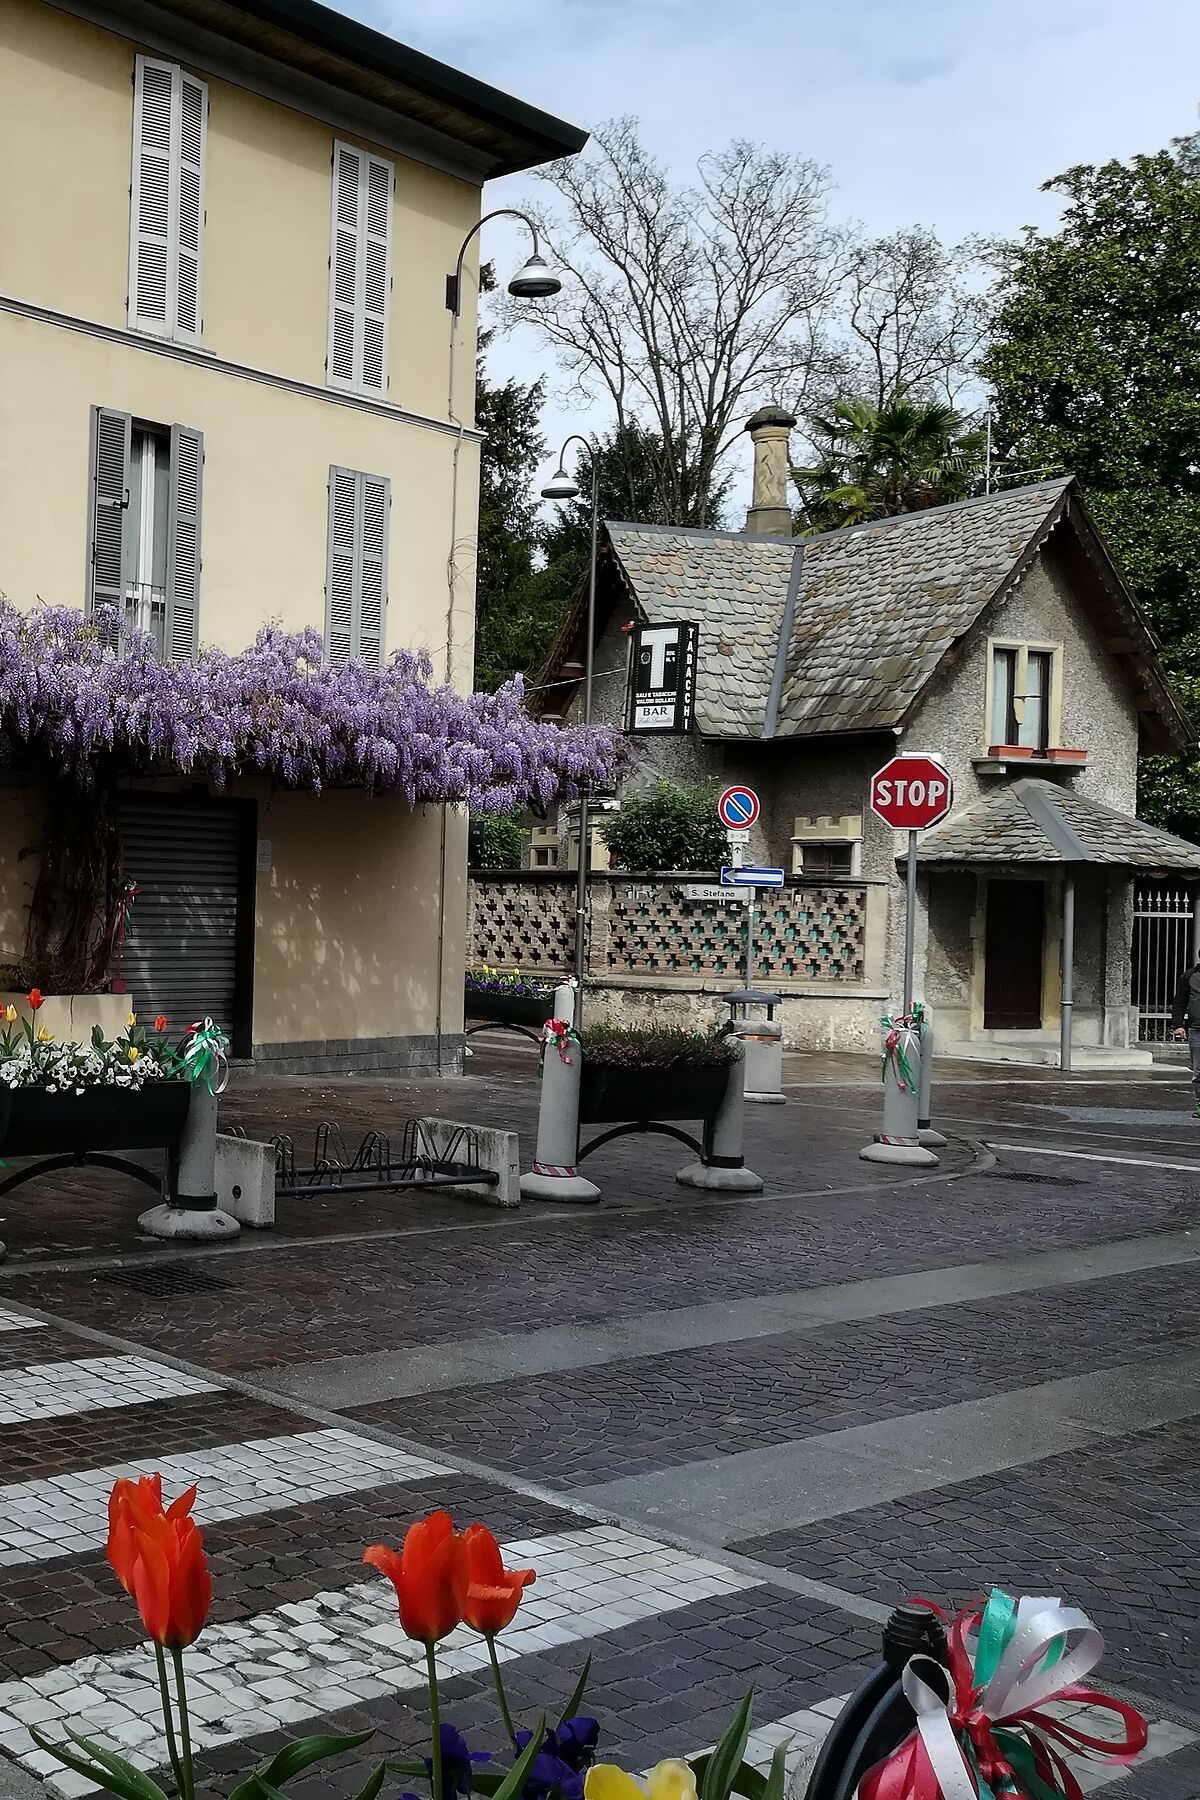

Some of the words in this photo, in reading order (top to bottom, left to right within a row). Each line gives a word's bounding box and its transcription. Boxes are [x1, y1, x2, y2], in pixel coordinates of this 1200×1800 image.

[641, 628, 678, 688] T
[683, 628, 695, 730] TABACCHI
[643, 707, 667, 716] BAR
[876, 780, 945, 807] STOP
[691, 889, 699, 897] S.
[703, 889, 735, 897] Stefano
